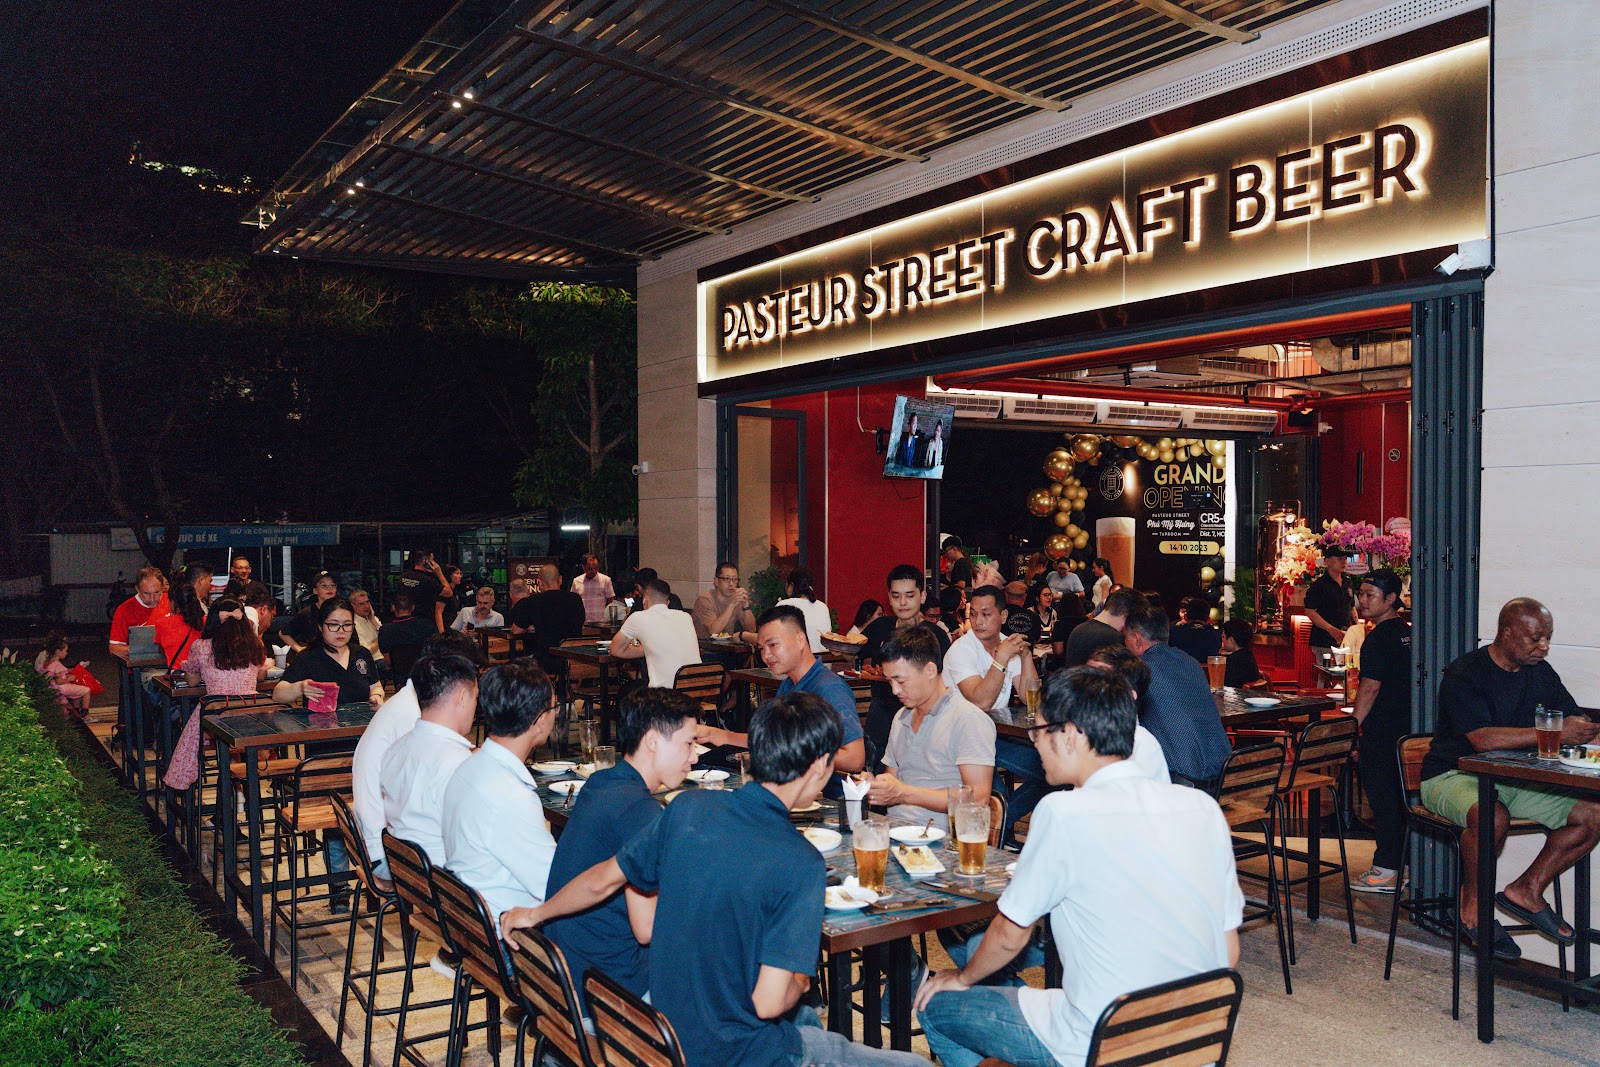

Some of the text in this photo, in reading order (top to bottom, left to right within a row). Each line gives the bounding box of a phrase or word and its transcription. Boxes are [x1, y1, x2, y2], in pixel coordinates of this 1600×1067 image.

[721, 121, 1427, 349] PASTEUR STREET CRAFT BEER
[1153, 462, 1226, 486] GRAND
[1143, 485, 1226, 509] OPEN
[1169, 543, 1208, 552] 14/10/2023
